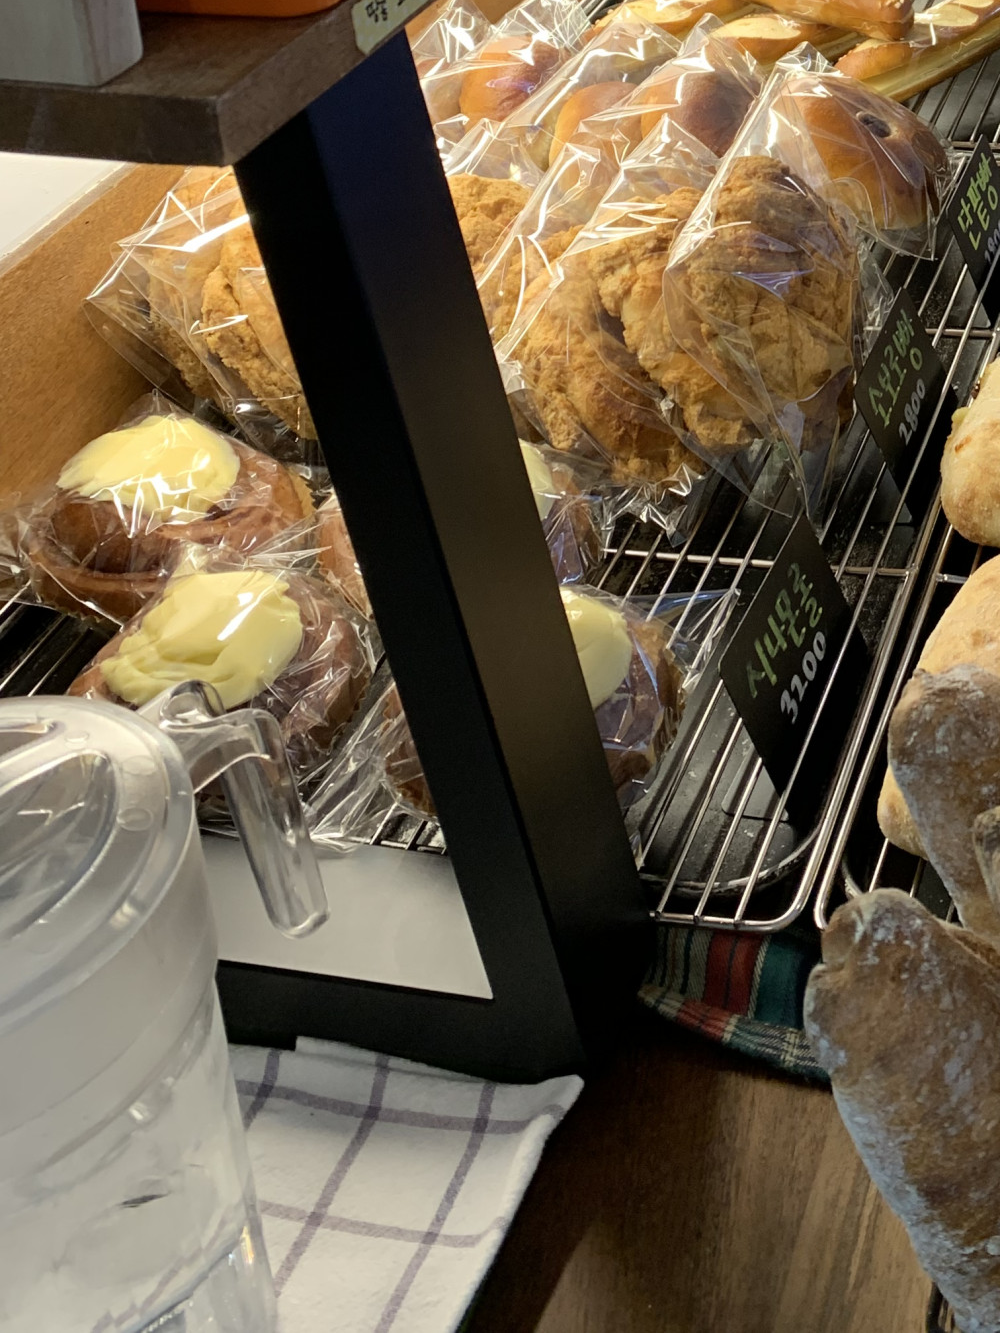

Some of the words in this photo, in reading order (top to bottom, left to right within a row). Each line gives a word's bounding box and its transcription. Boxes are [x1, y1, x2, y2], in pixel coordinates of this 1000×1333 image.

[957, 152, 998, 251] 단팥빵
[868, 308, 923, 429] 소보로빵
[899, 378, 926, 446] 2800
[746, 563, 823, 699] 시나몬롤
[780, 631, 827, 725] 3200
